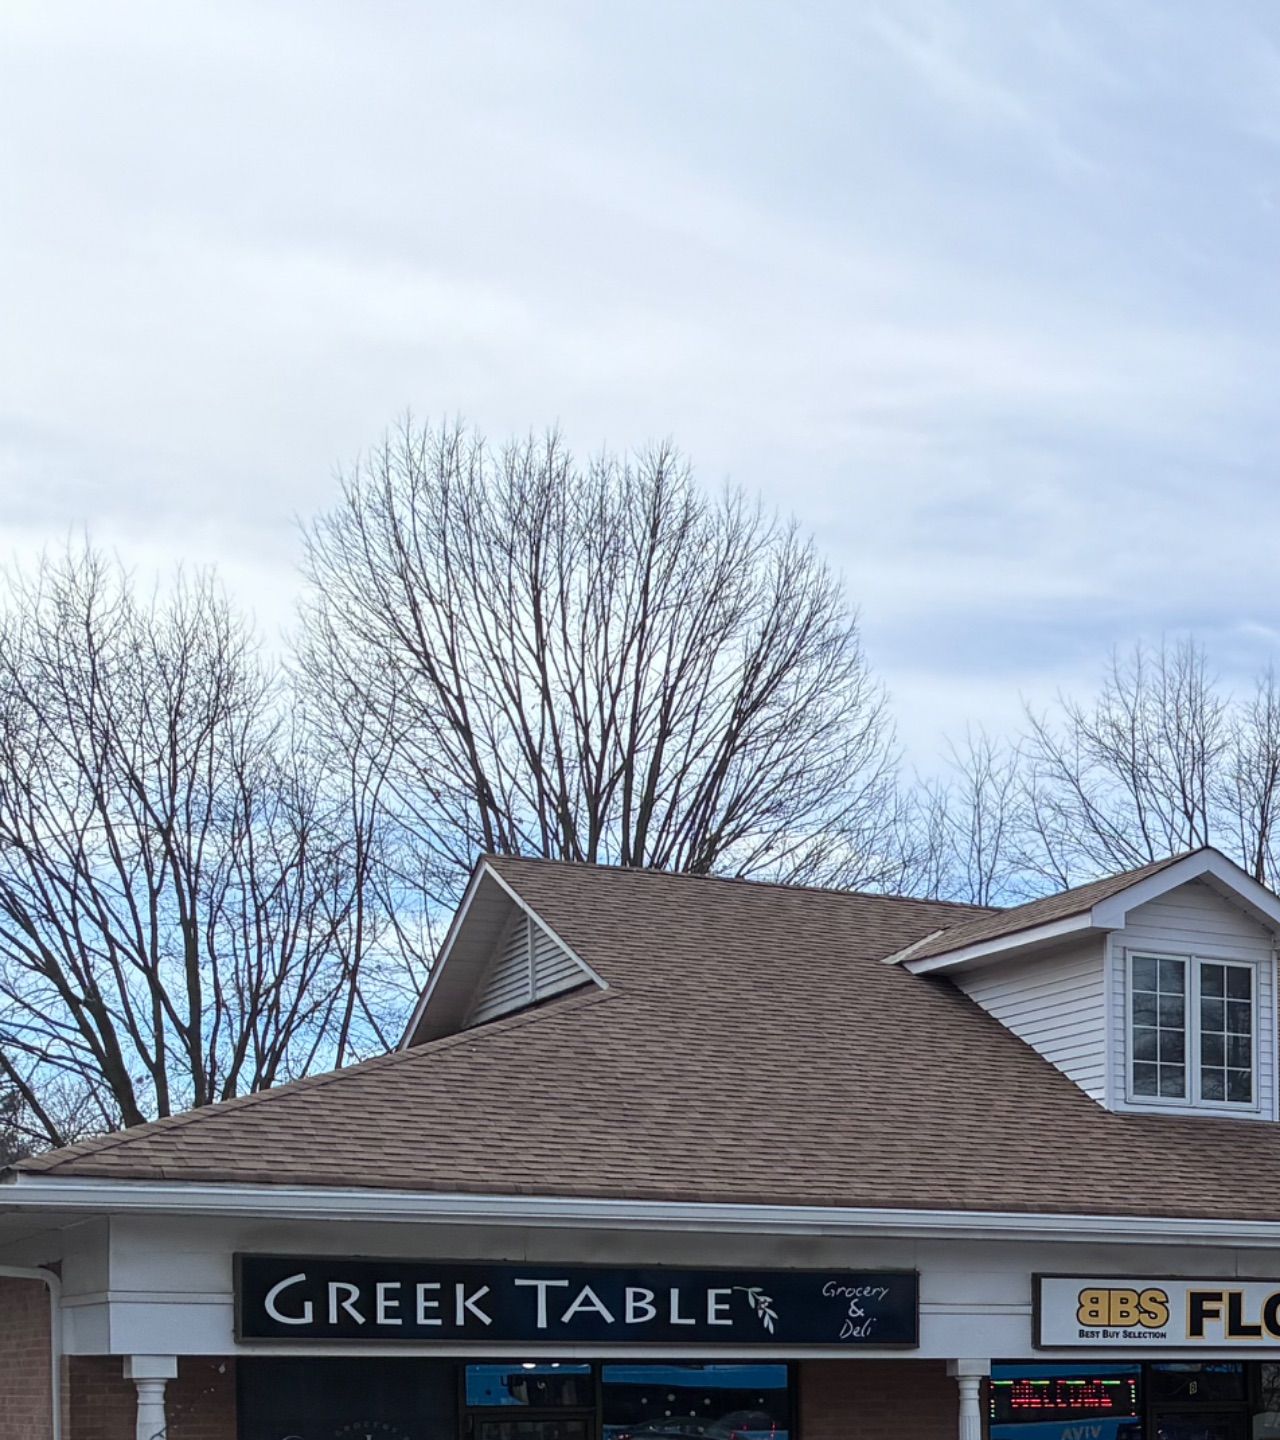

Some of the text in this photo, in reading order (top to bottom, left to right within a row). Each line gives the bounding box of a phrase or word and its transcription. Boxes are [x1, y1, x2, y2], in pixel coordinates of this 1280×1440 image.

[264, 1273, 733, 1328] GREEK TABLE
[822, 1280, 889, 1301] Grocery
[847, 1299, 864, 1317] &
[838, 1317, 877, 1339] Deli
